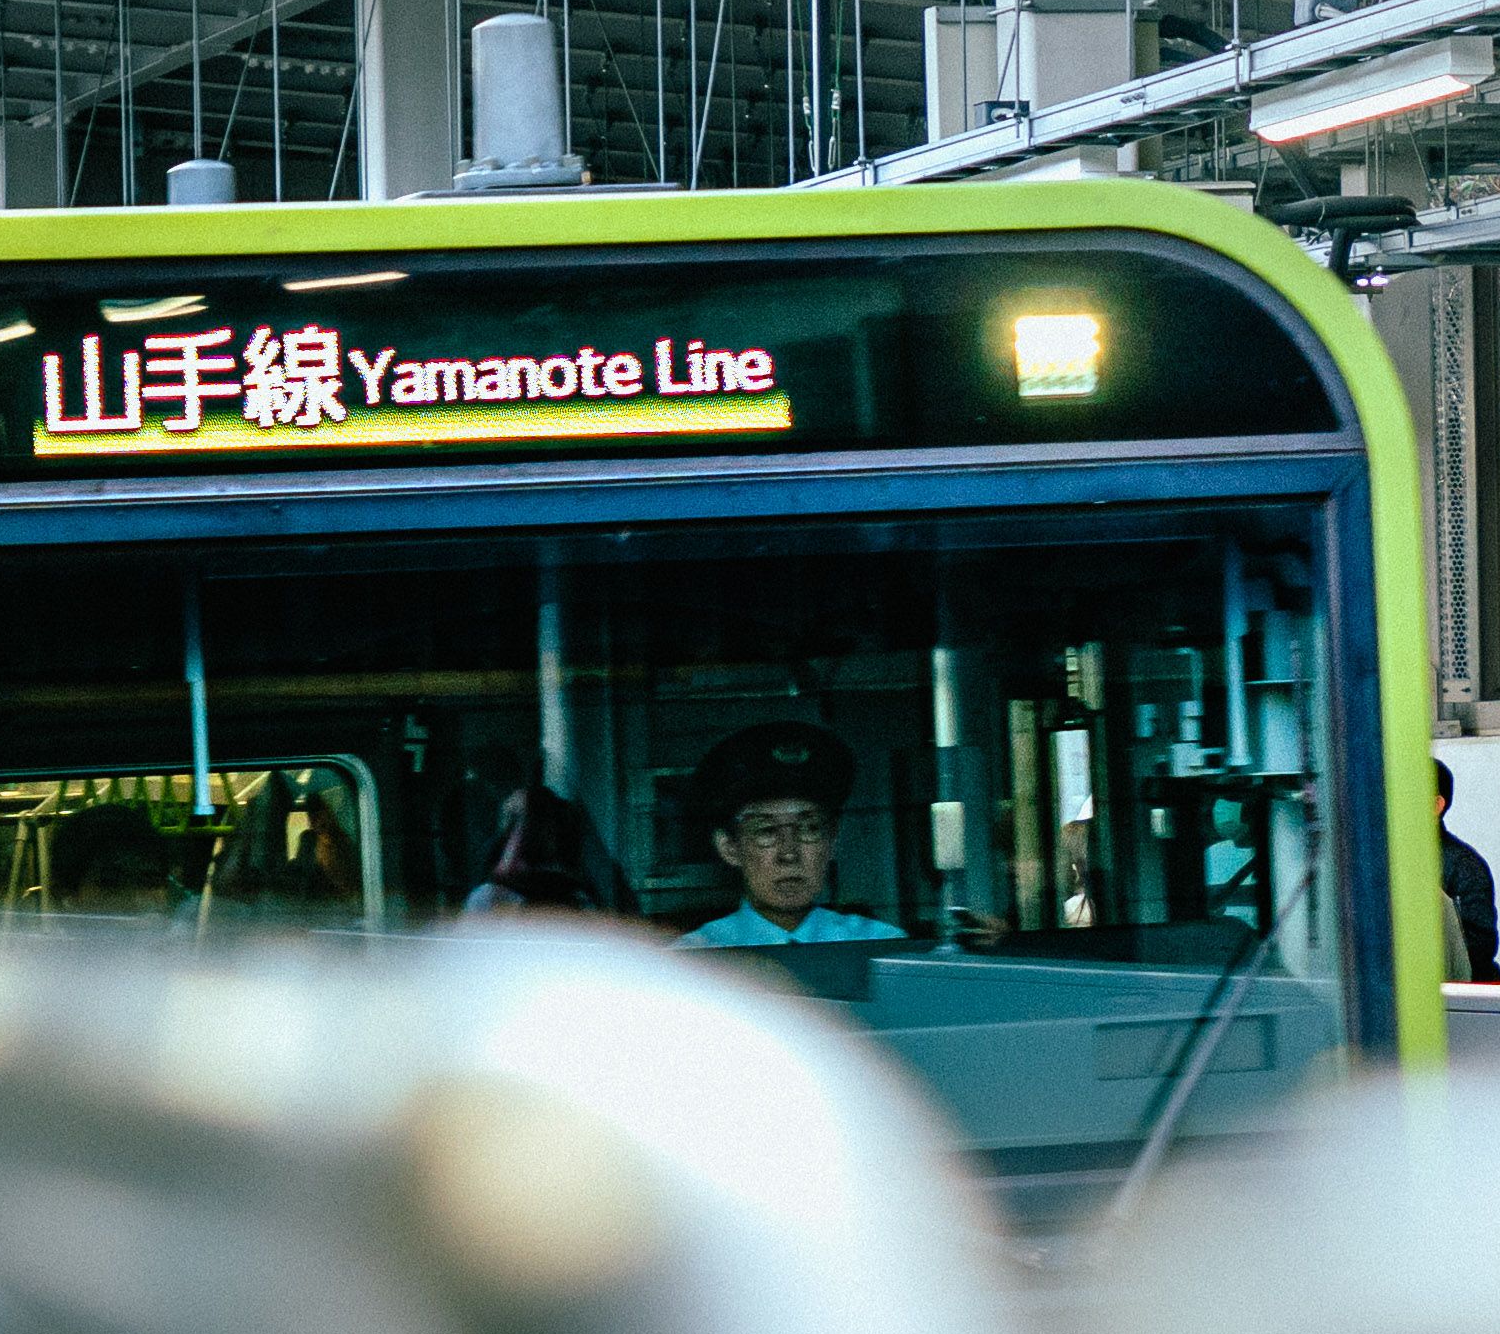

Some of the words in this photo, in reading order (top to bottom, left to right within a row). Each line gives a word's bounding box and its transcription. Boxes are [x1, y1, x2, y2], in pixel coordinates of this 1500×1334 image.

[41, 324, 349, 433] 山手線
[348, 347, 642, 406] Yamanote
[656, 338, 776, 395] Line
